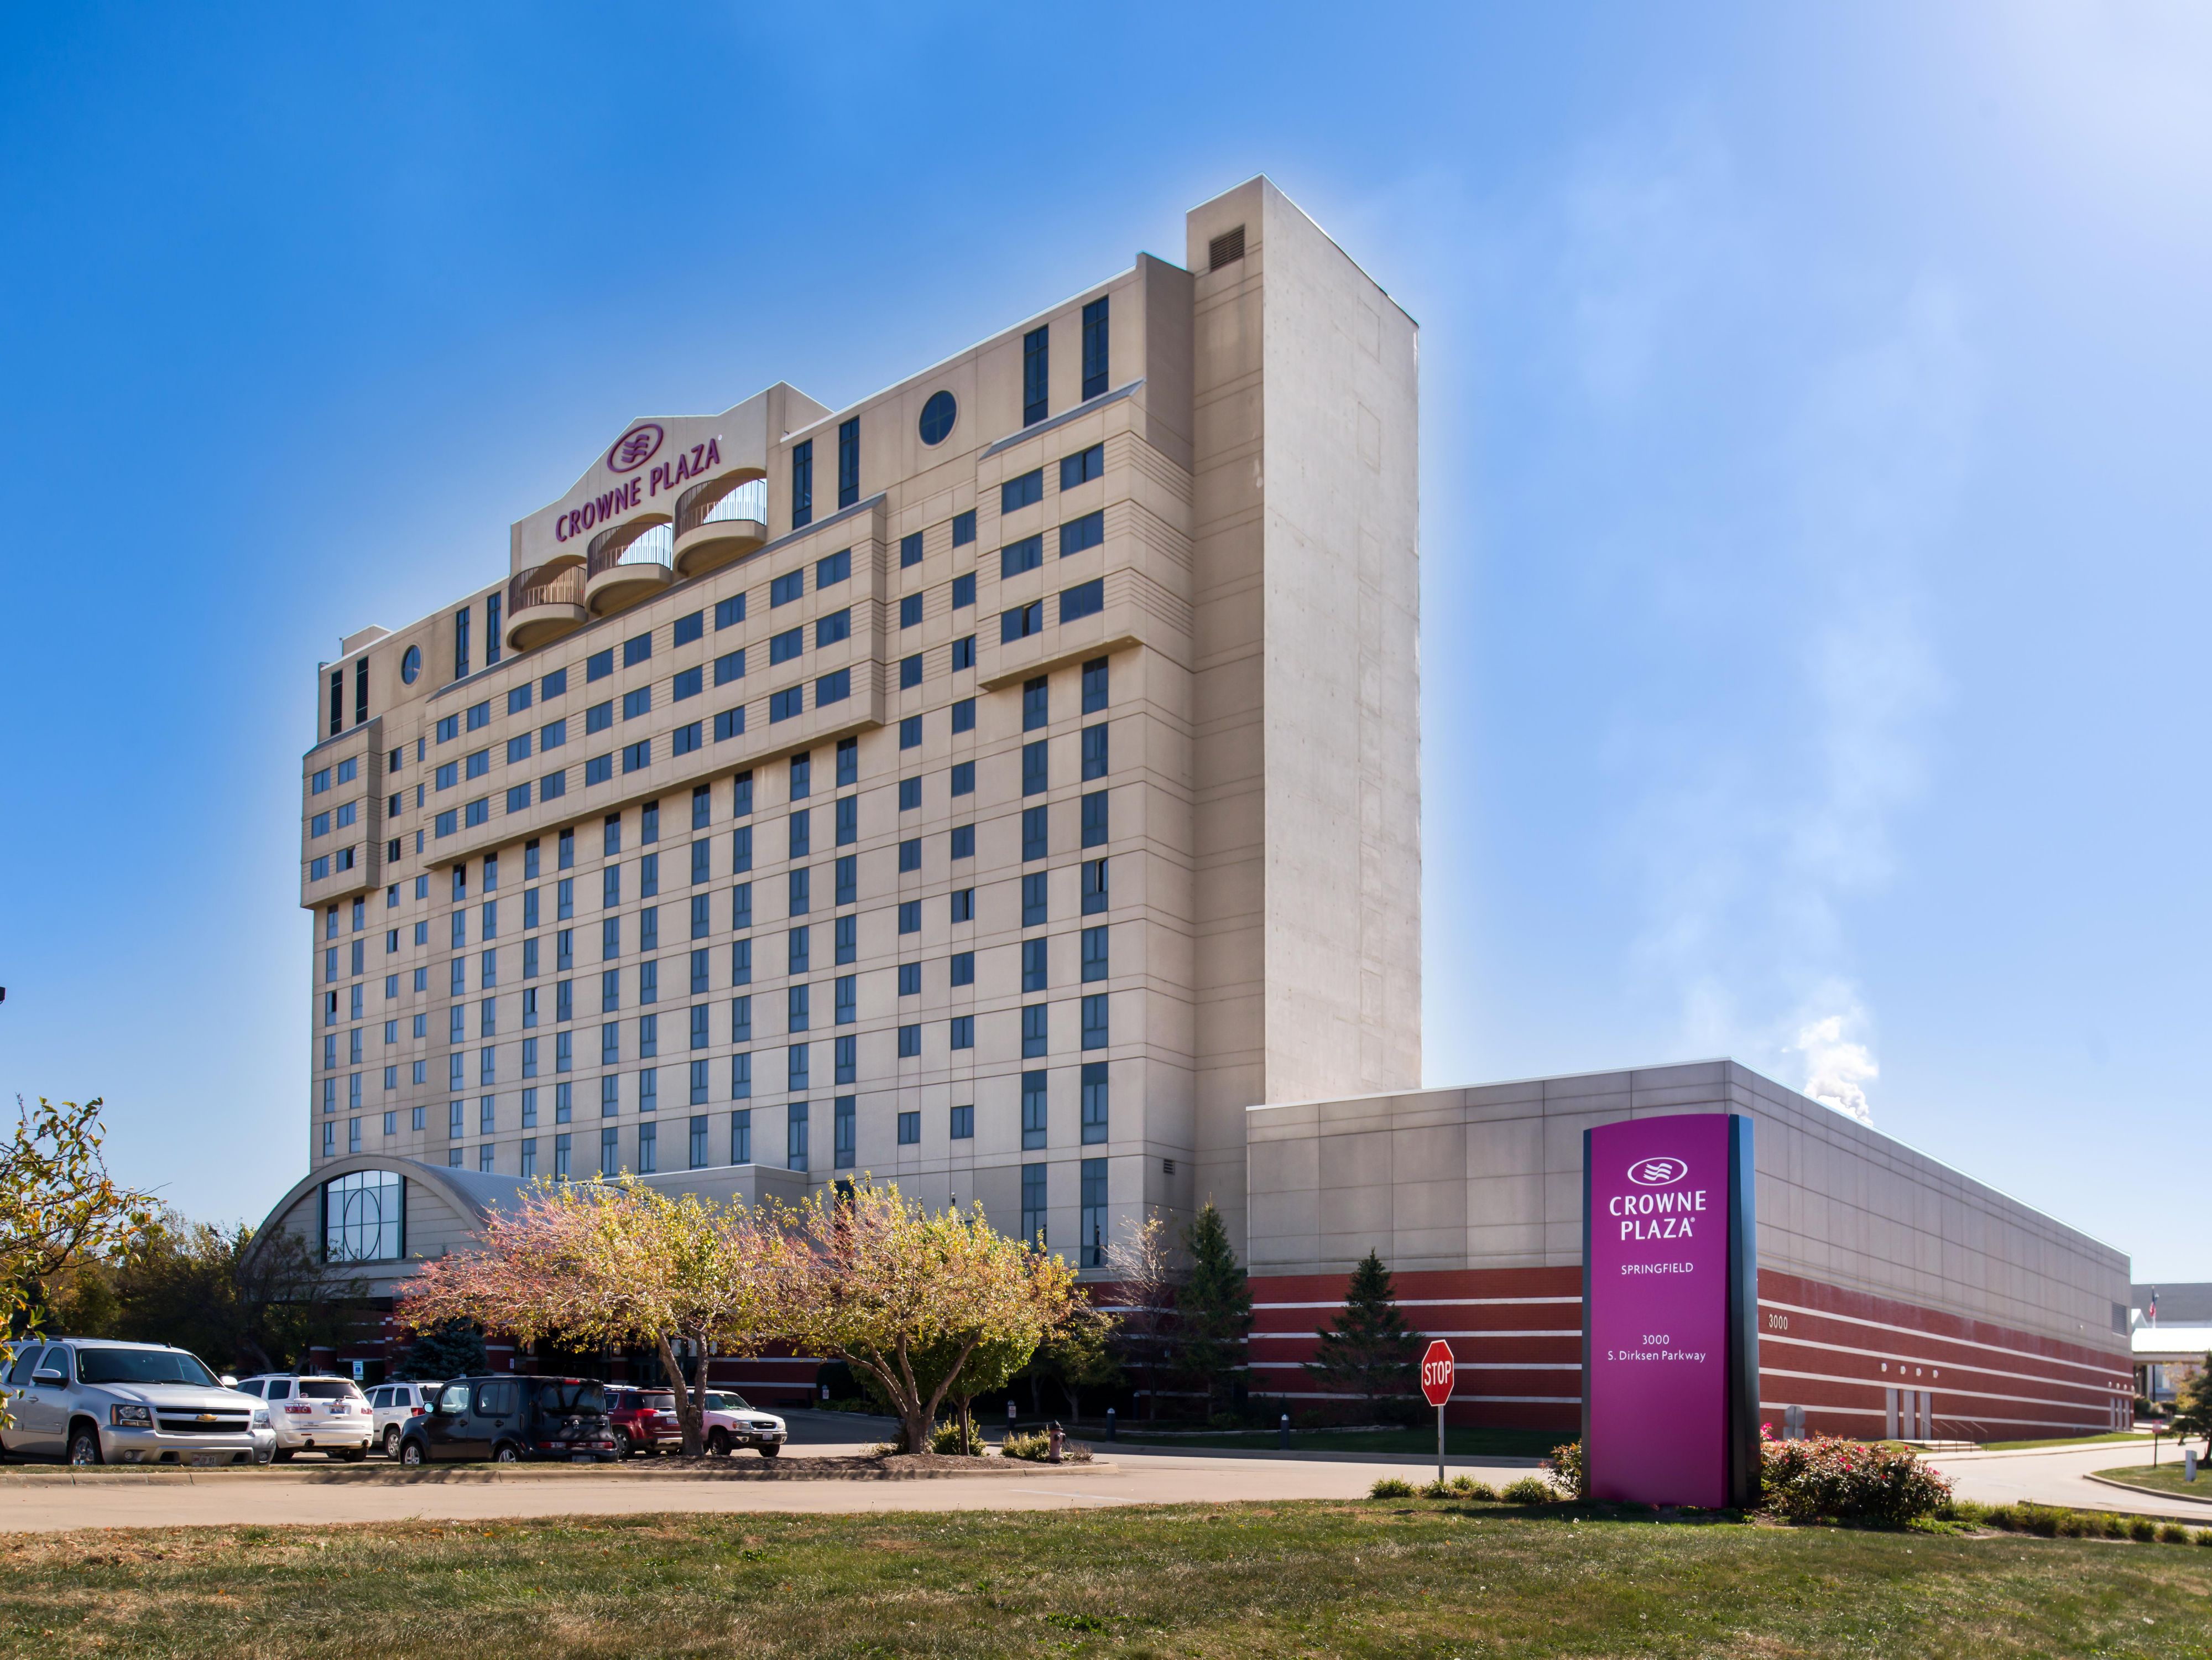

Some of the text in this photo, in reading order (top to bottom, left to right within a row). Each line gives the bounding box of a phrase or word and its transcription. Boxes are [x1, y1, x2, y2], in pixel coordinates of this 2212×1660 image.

[555, 438, 721, 542] CROWNE PLAZA
[1609, 1190, 1707, 1216] CROWNE
[1621, 1262, 1694, 1275] SPRINGFIELD
[1768, 1313, 1788, 1330] 3000
[1642, 1334, 1670, 1345] 3000
[1608, 1349, 1706, 1364] S. Dirksen Parkway
[1424, 1360, 1452, 1386] STOP
